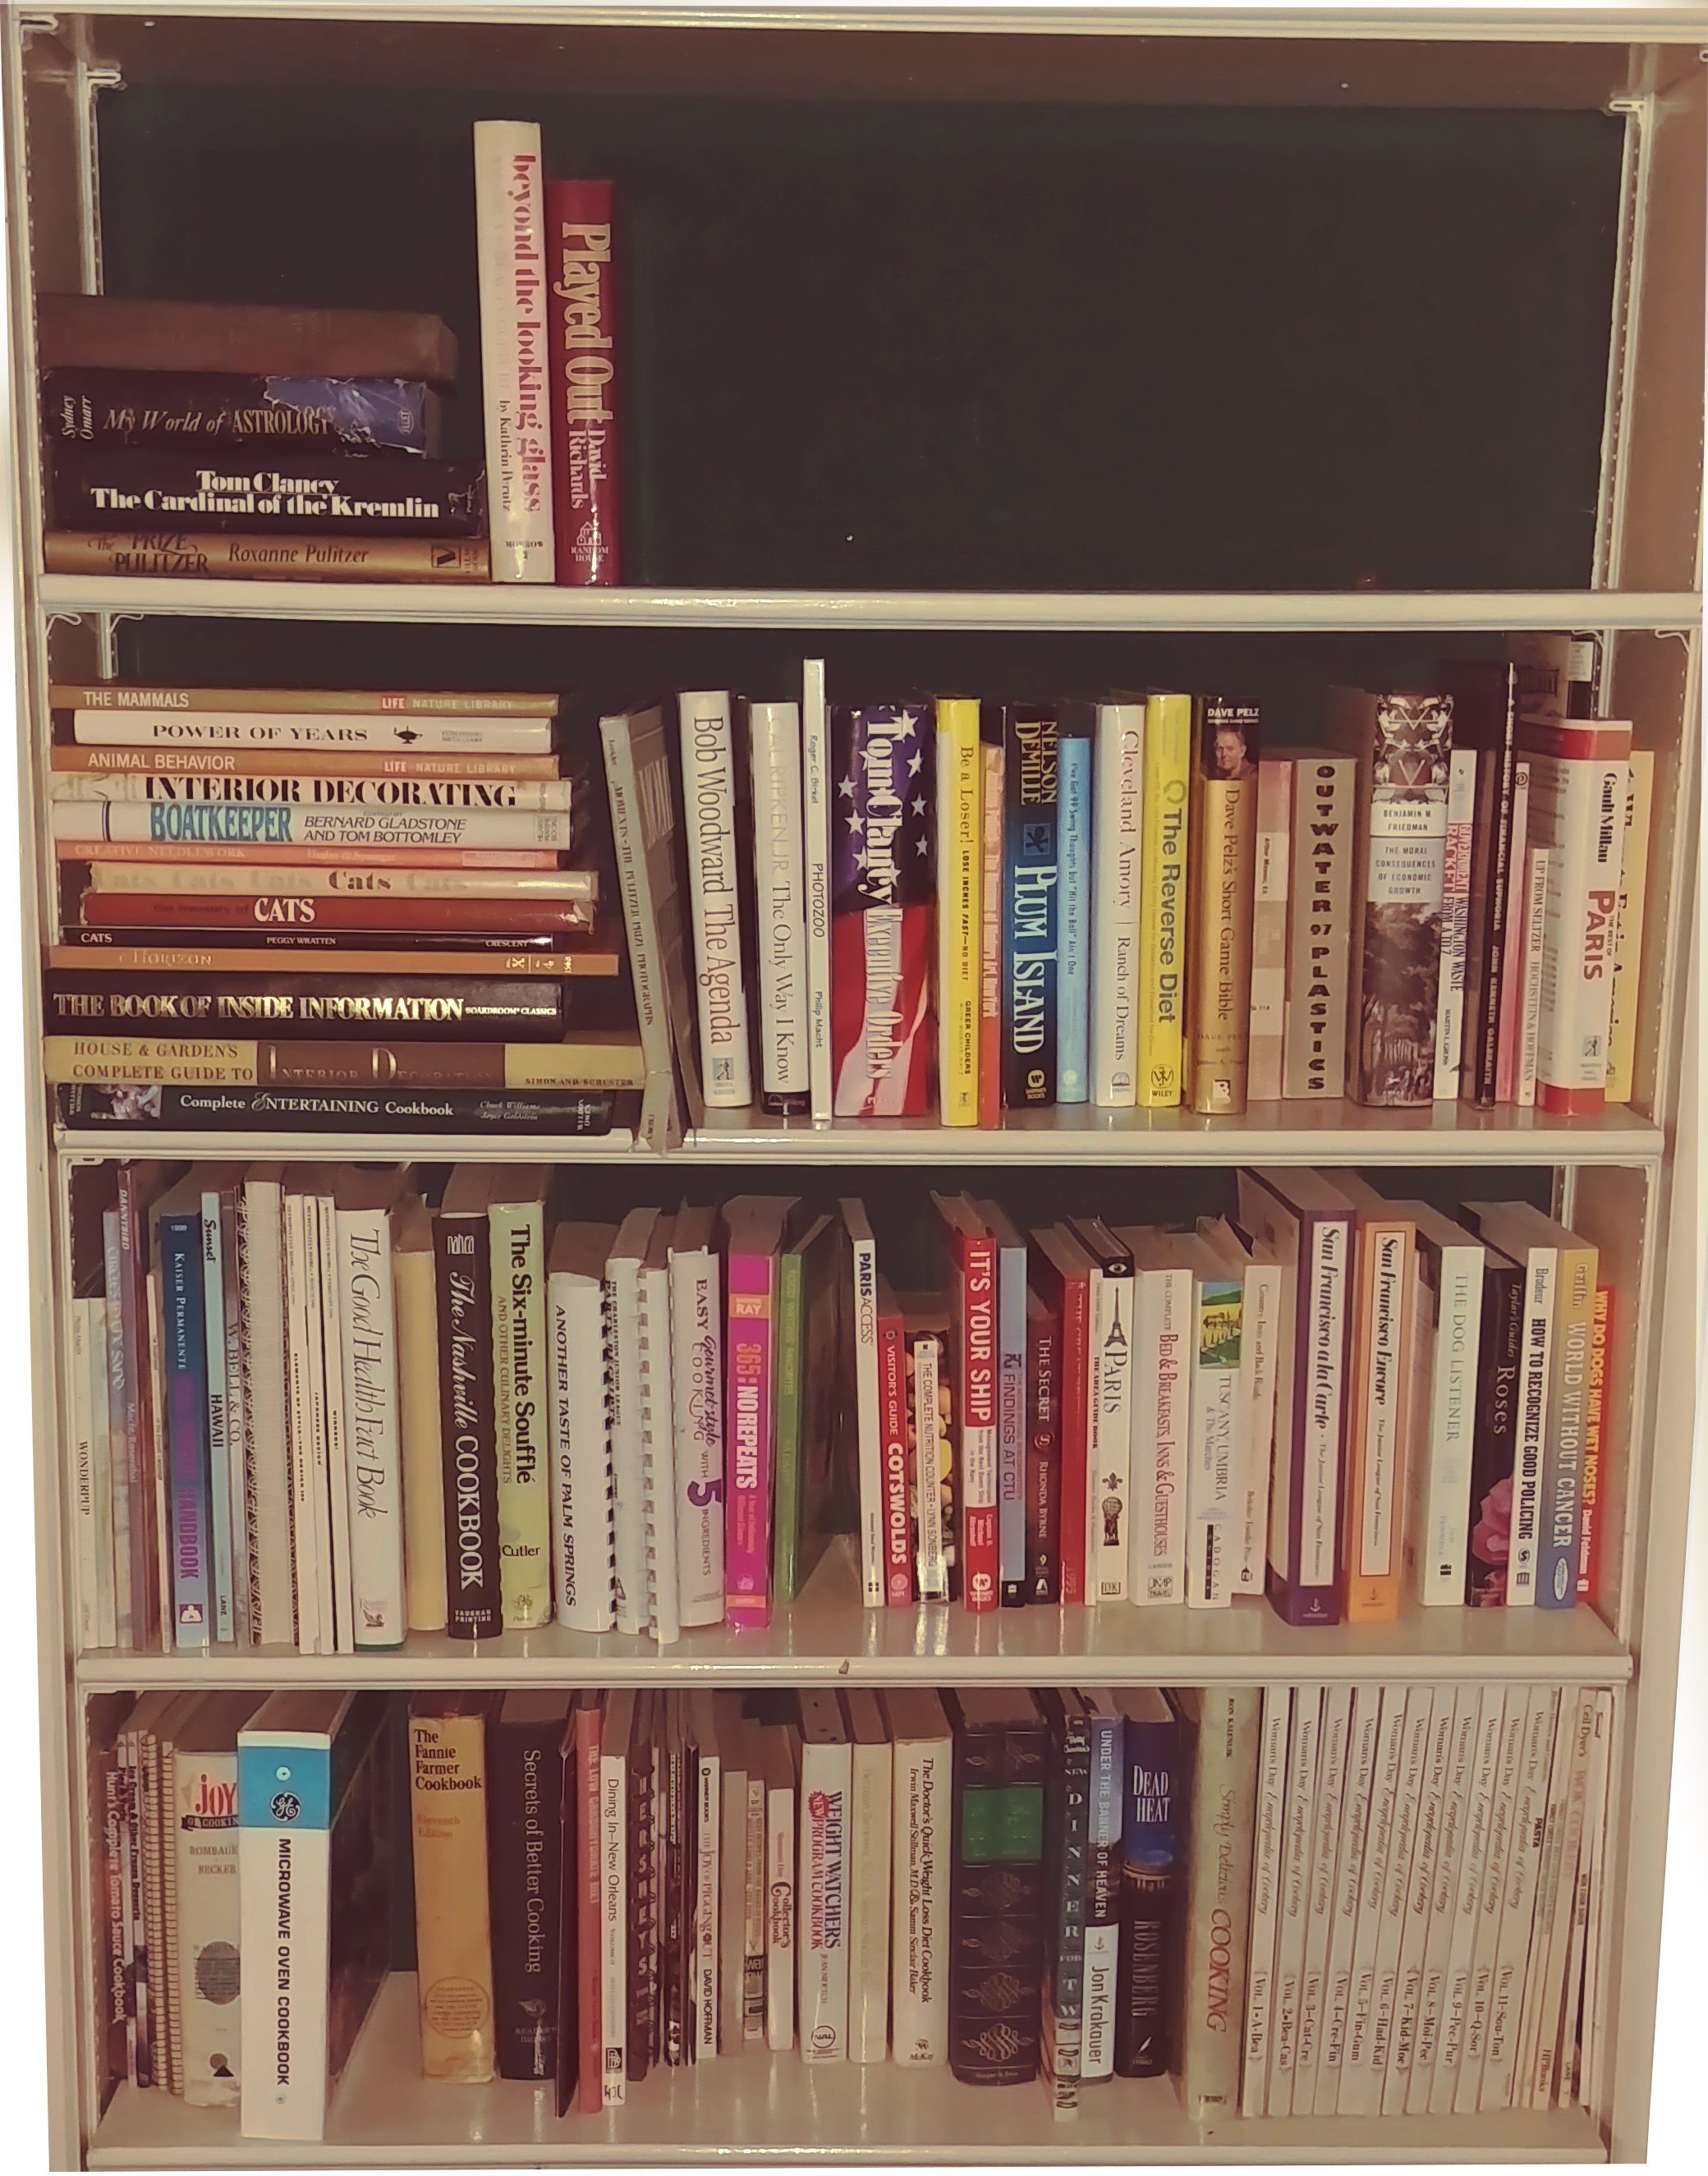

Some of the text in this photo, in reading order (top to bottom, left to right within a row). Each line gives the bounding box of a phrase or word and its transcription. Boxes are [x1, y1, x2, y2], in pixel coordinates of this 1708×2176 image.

[507, 154, 539, 260] beyond
[516, 269, 539, 314] the
[553, 222, 613, 425] Played Out
[515, 321, 543, 430] looking
[103, 407, 335, 435] My World of ASTROLOGY
[196, 471, 339, 495] Tom Clancy
[516, 438, 545, 512] glass
[569, 429, 606, 509] David Richards
[90, 489, 439, 518] The Cardinal of the Kremlin
[228, 544, 370, 565] Roxanne Pulitzer
[84, 691, 189, 708] THE MAMMALS
[382, 698, 512, 709] LIFE NATURE LIBRARY
[153, 725, 367, 741] POWER OF YEARS
[89, 753, 235, 770] ANIMAL BEHAVIOR
[384, 761, 516, 774] LIFE NATURE LIBRARY
[1040, 721, 1057, 805] NELSON
[146, 777, 516, 807] INTERIOR DECORATING
[150, 802, 292, 842] BOATKEEPER
[303, 815, 467, 830] BERNARD GLADSTONE
[303, 829, 461, 843] AND TOM BOTTOMLEY
[694, 716, 740, 1044] Bob Woodward The Agenda
[1376, 860, 1435, 868] CONSEQUENCES
[254, 897, 315, 923] CATS
[812, 863, 824, 938] PHOTOZOO
[1531, 861, 1545, 953] UP FROM SELTZER
[80, 933, 112, 943] CATS
[1311, 925, 1332, 935] 97
[53, 994, 464, 1021] THE BOOK OF INSIDE INFORMATION
[813, 991, 823, 1016] Philip
[73, 1065, 253, 1081] COMPLETE GUIDE TO
[204, 1219, 216, 1264] Sunset
[174, 1253, 187, 1370] KAISER PERMANENTE
[351, 1229, 388, 1518] The Good Health Fact Book
[511, 1224, 536, 1484] The Six-minute Soufflé
[887, 1345, 898, 1435] VISITOR'S GUIDE
[1518, 1269, 1549, 1540] Brodeur HOW TO RECOGNIZE GOOD POLICING
[1553, 1263, 1588, 1547] Griffin WORLD WITHOUT CANCER
[449, 1272, 484, 1590] The Nashville COOKBOOK
[1038, 1336, 1052, 1538] THE SECRET RHONDA BYRNE
[556, 1305, 576, 1606] ANOTHER TASTE OF PALM SPRINGS
[923, 1363, 936, 1567] THE COMPLETE NUTRITION COUNTER LYNN SONBERG
[79, 1441, 90, 1516] WONDERPUP
[888, 1443, 907, 1564] COTSWOLDS
[503, 1545, 540, 1557] Cutler
[414, 1729, 438, 1743] The
[416, 1745, 456, 1759] Fannie
[416, 1761, 461, 1774] Farmer
[416, 1776, 482, 1790] Cookbook
[1133, 1765, 1169, 1796] DEAD
[1136, 1797, 1171, 1822] HEAT
[1257, 1718, 1280, 1915] Woman's Day Encyclopedia of Cookery
[1532, 1818, 1543, 1848] PASTA
[810, 1794, 824, 1949] NEW PROGRAM COOKBOOK
[824, 1791, 842, 1949] WEIGHT WATCHERS
[920, 1758, 934, 2003] The Doctor's Quick Weight Loss Diet Cookbook
[278, 1839, 291, 2086] MICROWAVE OVEN COOKBOOK
[1089, 1967, 1109, 2064] Jon Krakauer
